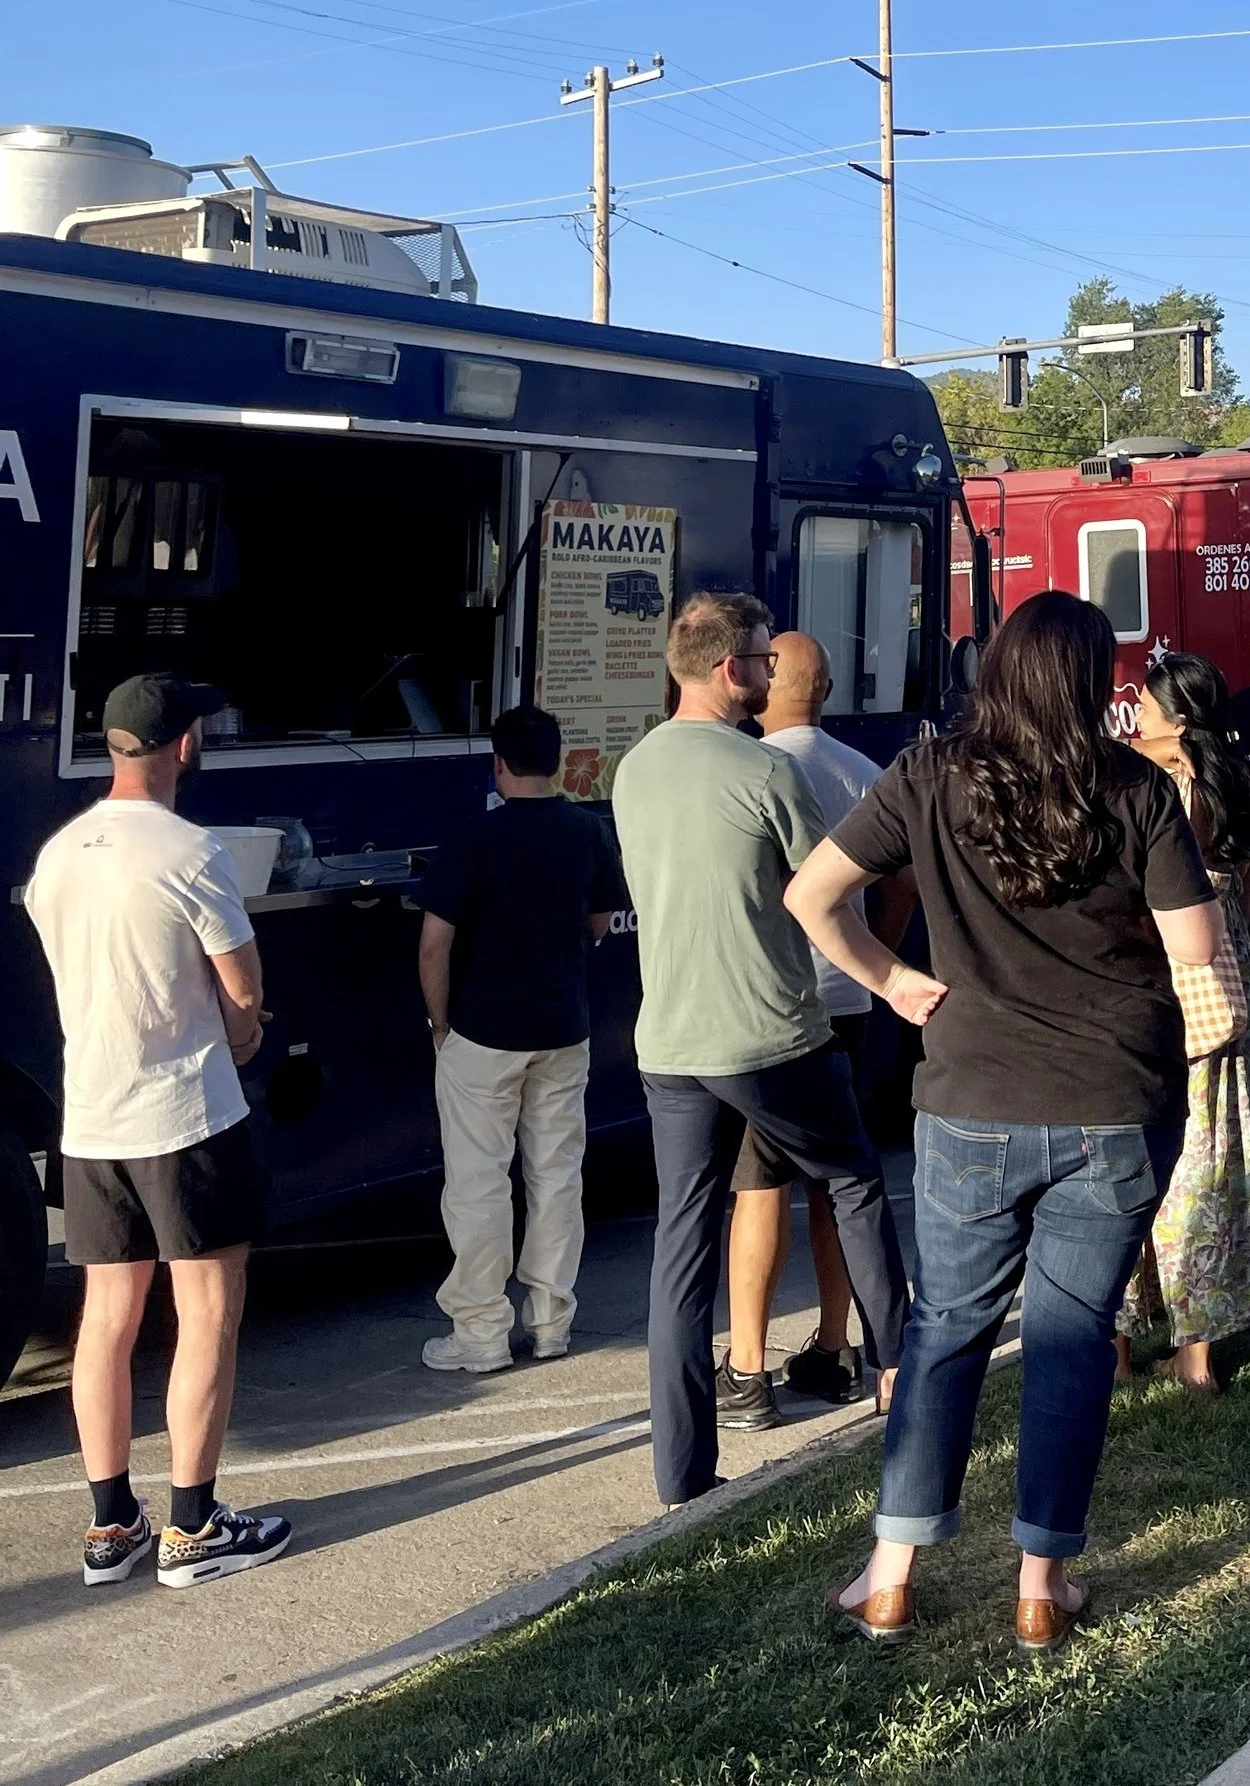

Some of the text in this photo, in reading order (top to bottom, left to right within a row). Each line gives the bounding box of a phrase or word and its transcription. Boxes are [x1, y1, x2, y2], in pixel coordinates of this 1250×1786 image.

[552, 521, 665, 554] MAKAYA
[1196, 543, 1242, 556] ORDENES
[633, 556, 662, 565] FLAVORS
[1205, 557, 1229, 574] 385
[551, 571, 582, 580] CHICKEN
[1205, 574, 1227, 592] 801
[628, 627, 656, 636] PLATTER
[605, 640, 652, 648] LOADED FRIES
[548, 648, 571, 657] VEGAN
